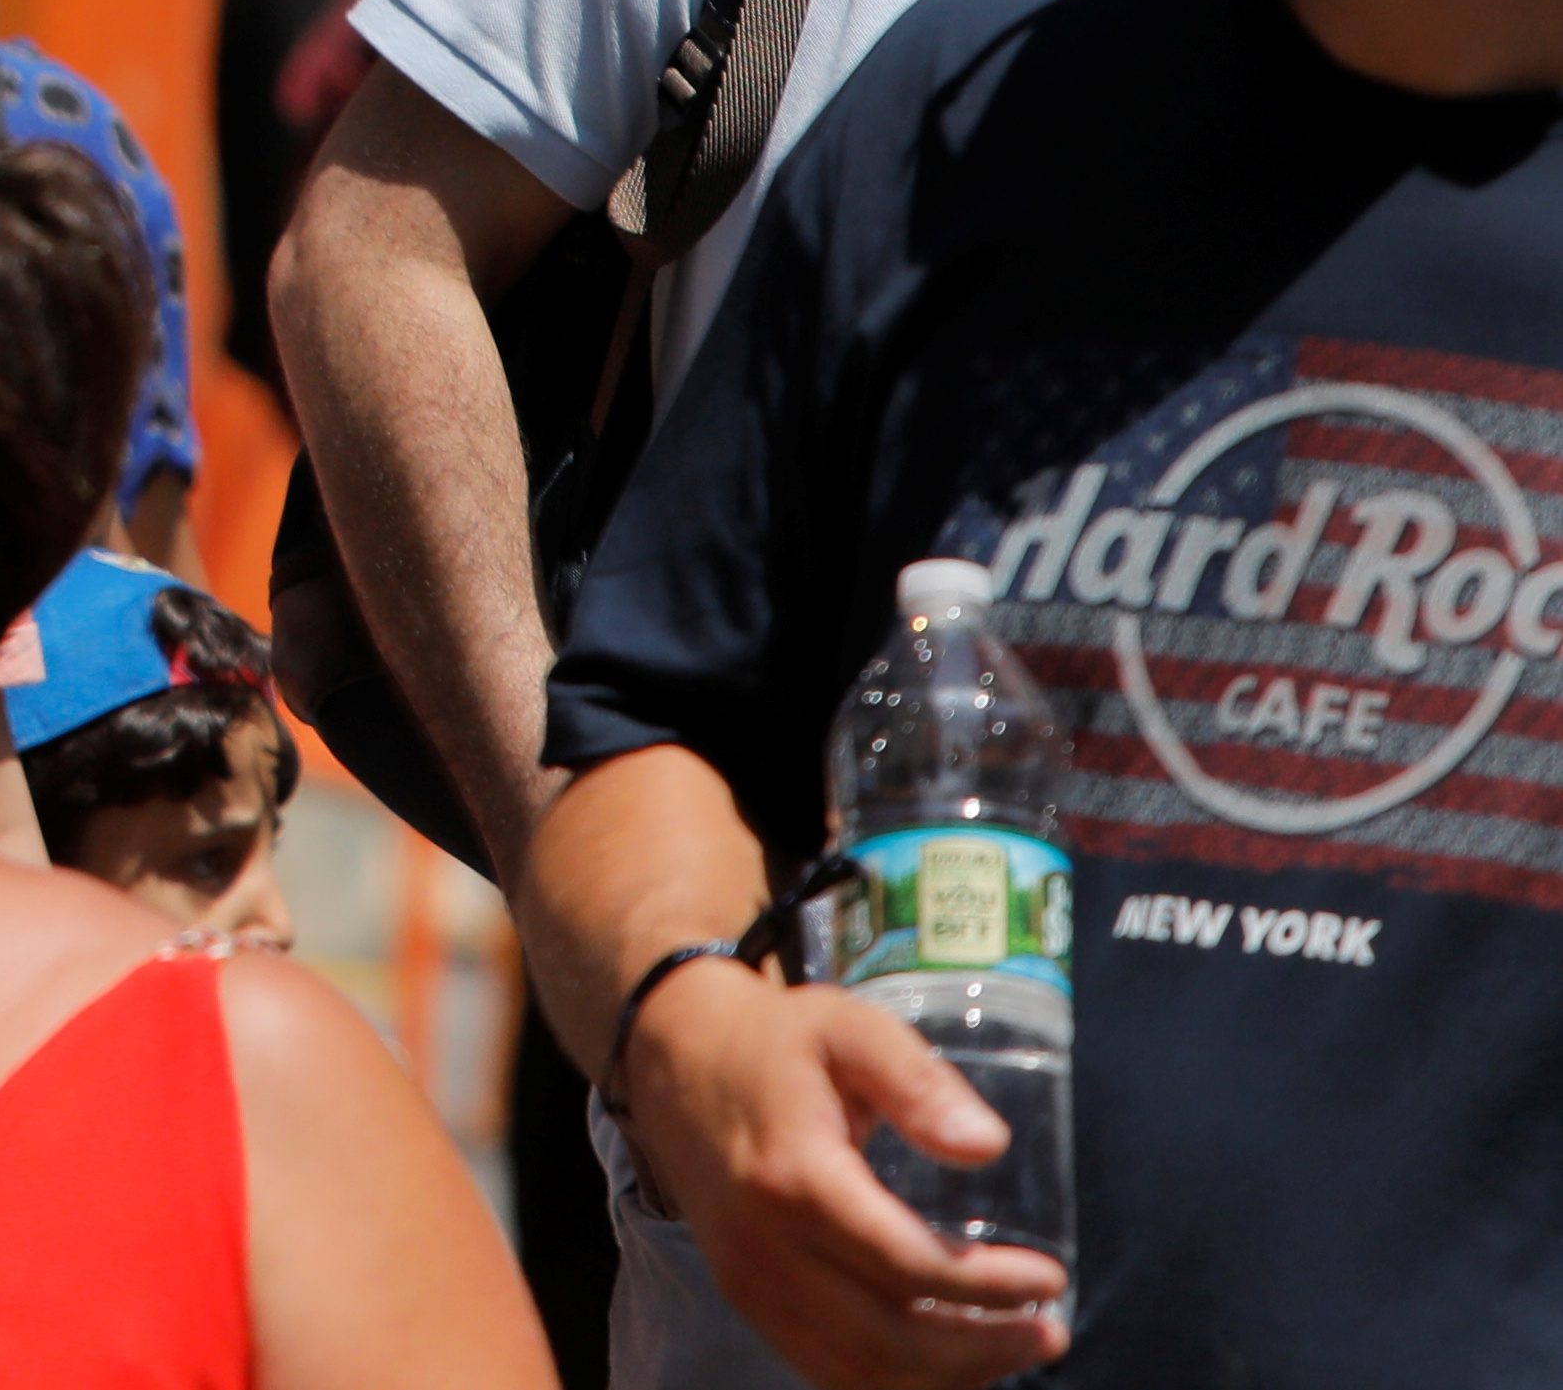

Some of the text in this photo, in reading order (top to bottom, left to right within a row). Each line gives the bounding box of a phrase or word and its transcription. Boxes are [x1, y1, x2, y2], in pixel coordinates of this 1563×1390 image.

[990, 462, 1343, 621] Hard
[1217, 673, 1391, 754] CAFE
[1112, 894, 1235, 950] NEW
[1239, 905, 1383, 967] YORK
